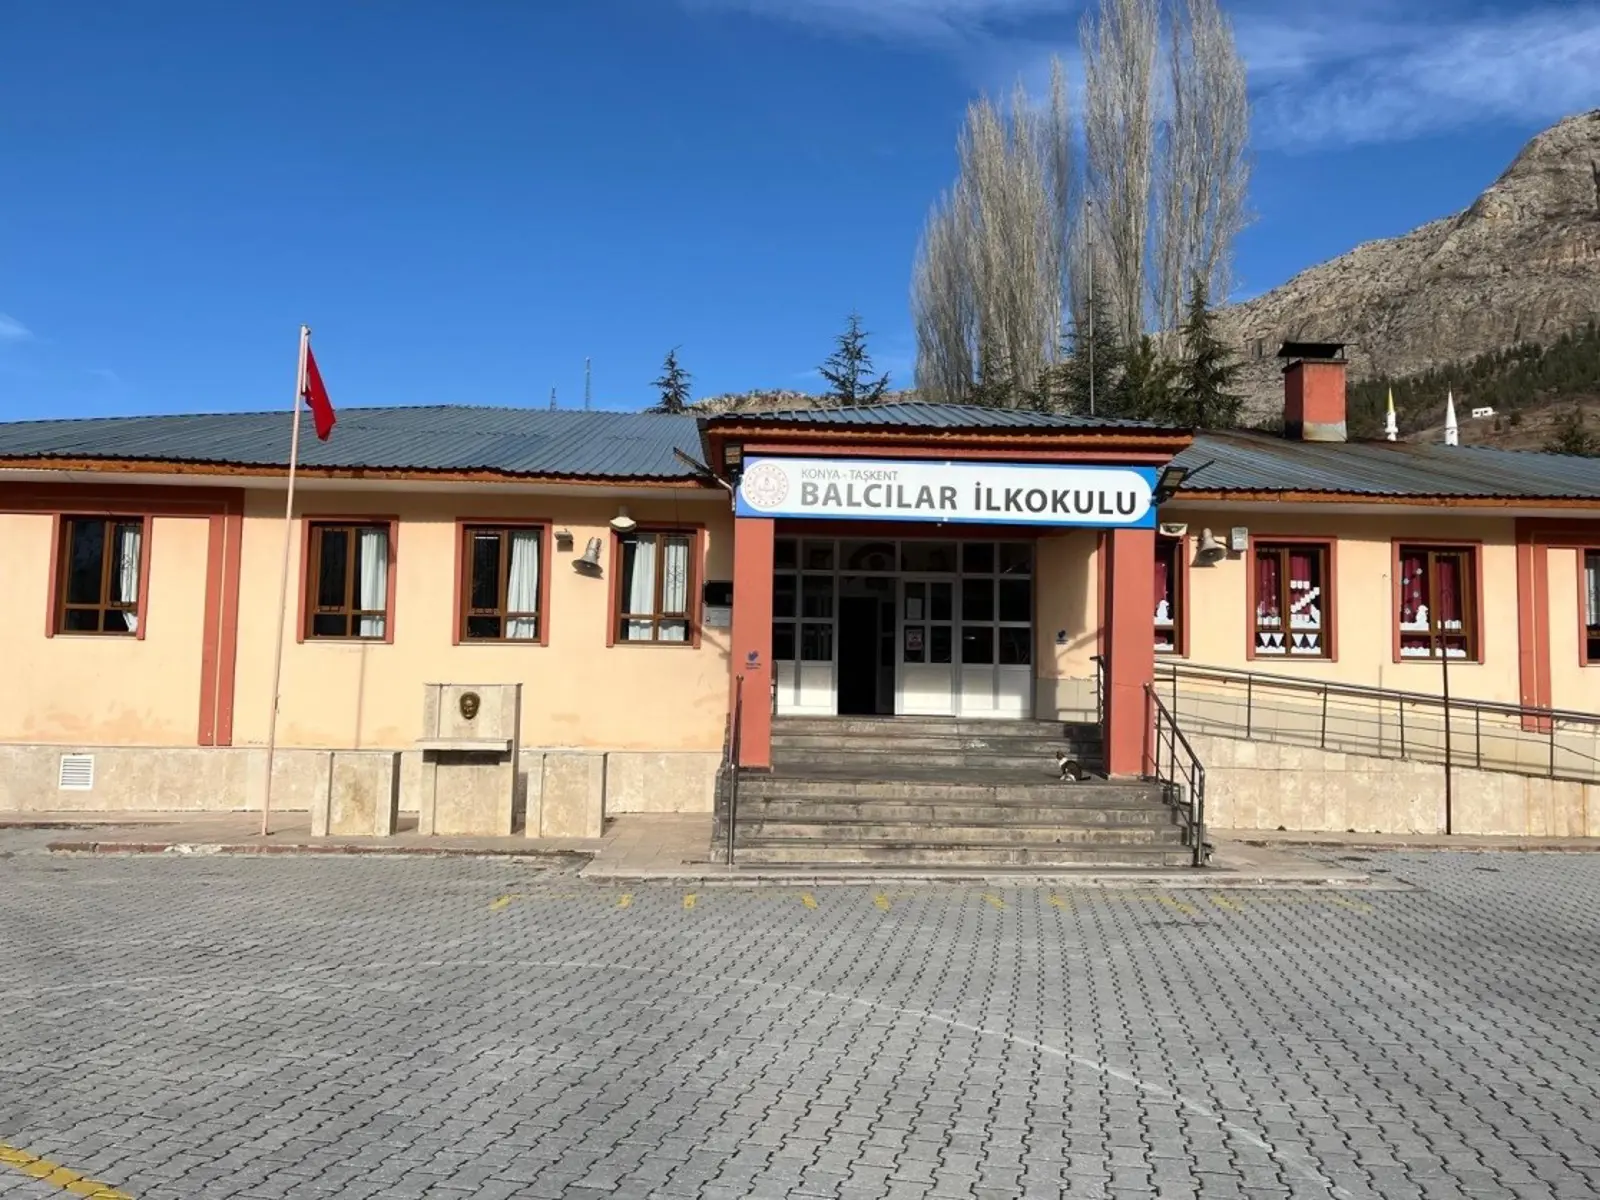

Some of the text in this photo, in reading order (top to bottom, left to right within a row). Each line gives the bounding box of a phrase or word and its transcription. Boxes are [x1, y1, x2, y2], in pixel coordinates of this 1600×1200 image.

[801, 468, 840, 480] KONYA
[849, 469, 898, 482] TAŞKENT
[801, 481, 1136, 515] BALCILAR İLKOKULU
